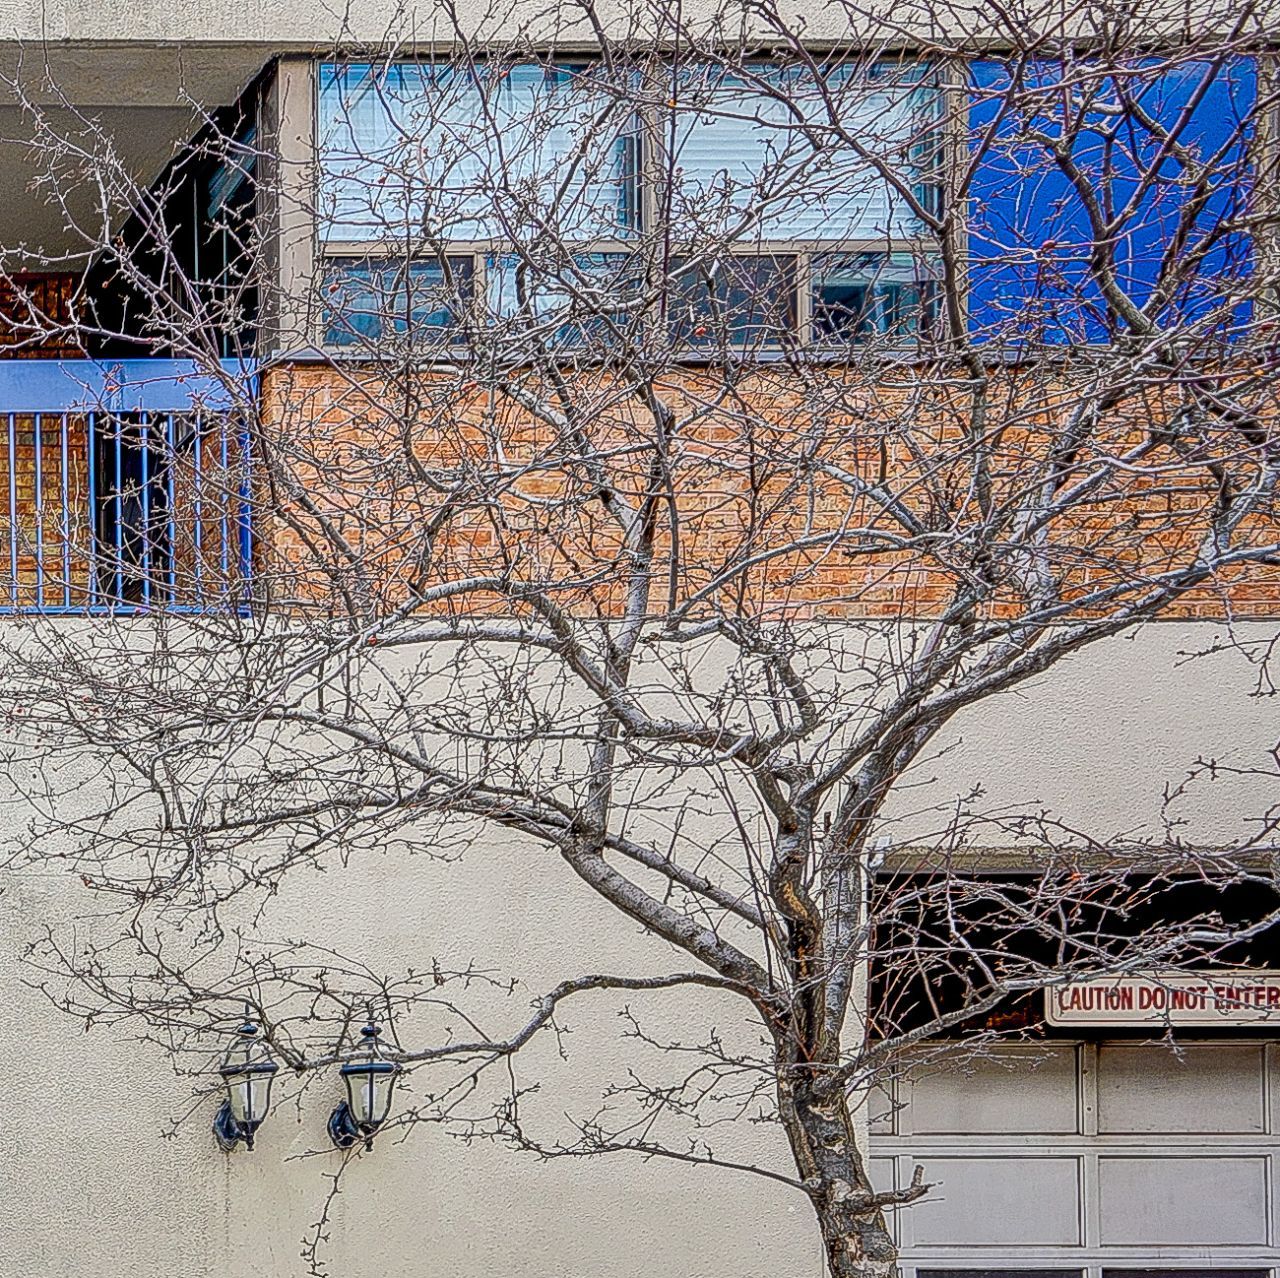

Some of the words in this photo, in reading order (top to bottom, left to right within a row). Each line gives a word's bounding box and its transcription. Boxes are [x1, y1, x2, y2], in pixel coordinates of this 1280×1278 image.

[1057, 987, 1133, 1011] CAUTION
[1139, 987, 1166, 1010] DO
[1171, 986, 1208, 1010] NOT
[1214, 986, 1280, 1010] ENTER
